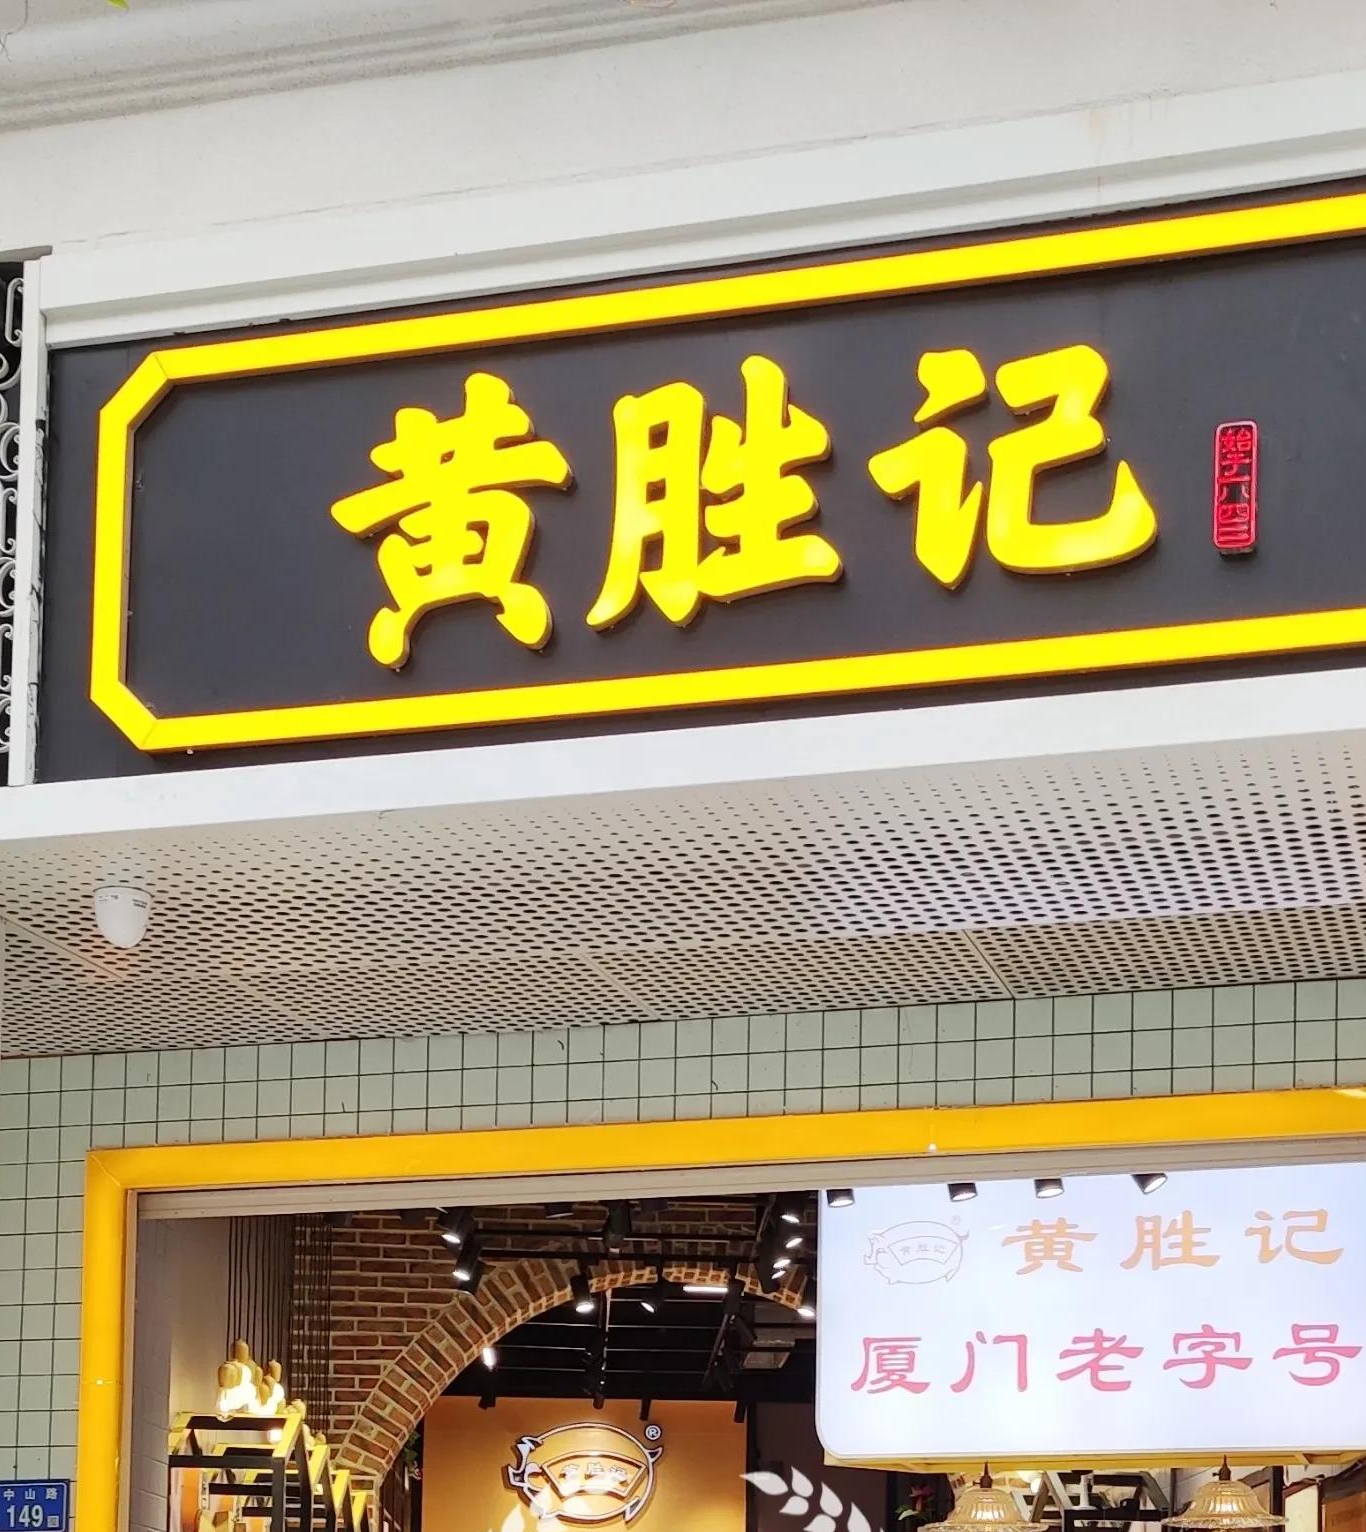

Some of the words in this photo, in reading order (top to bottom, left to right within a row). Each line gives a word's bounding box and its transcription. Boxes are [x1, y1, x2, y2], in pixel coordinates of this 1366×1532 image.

[331, 344, 1157, 671] 黄胜记
[1002, 1209, 1344, 1276] 黄胜记
[850, 1323, 1363, 1394] 厦门老字号
[3, 1488, 58, 1501] 中山路
[7, 1504, 43, 1528] 149
